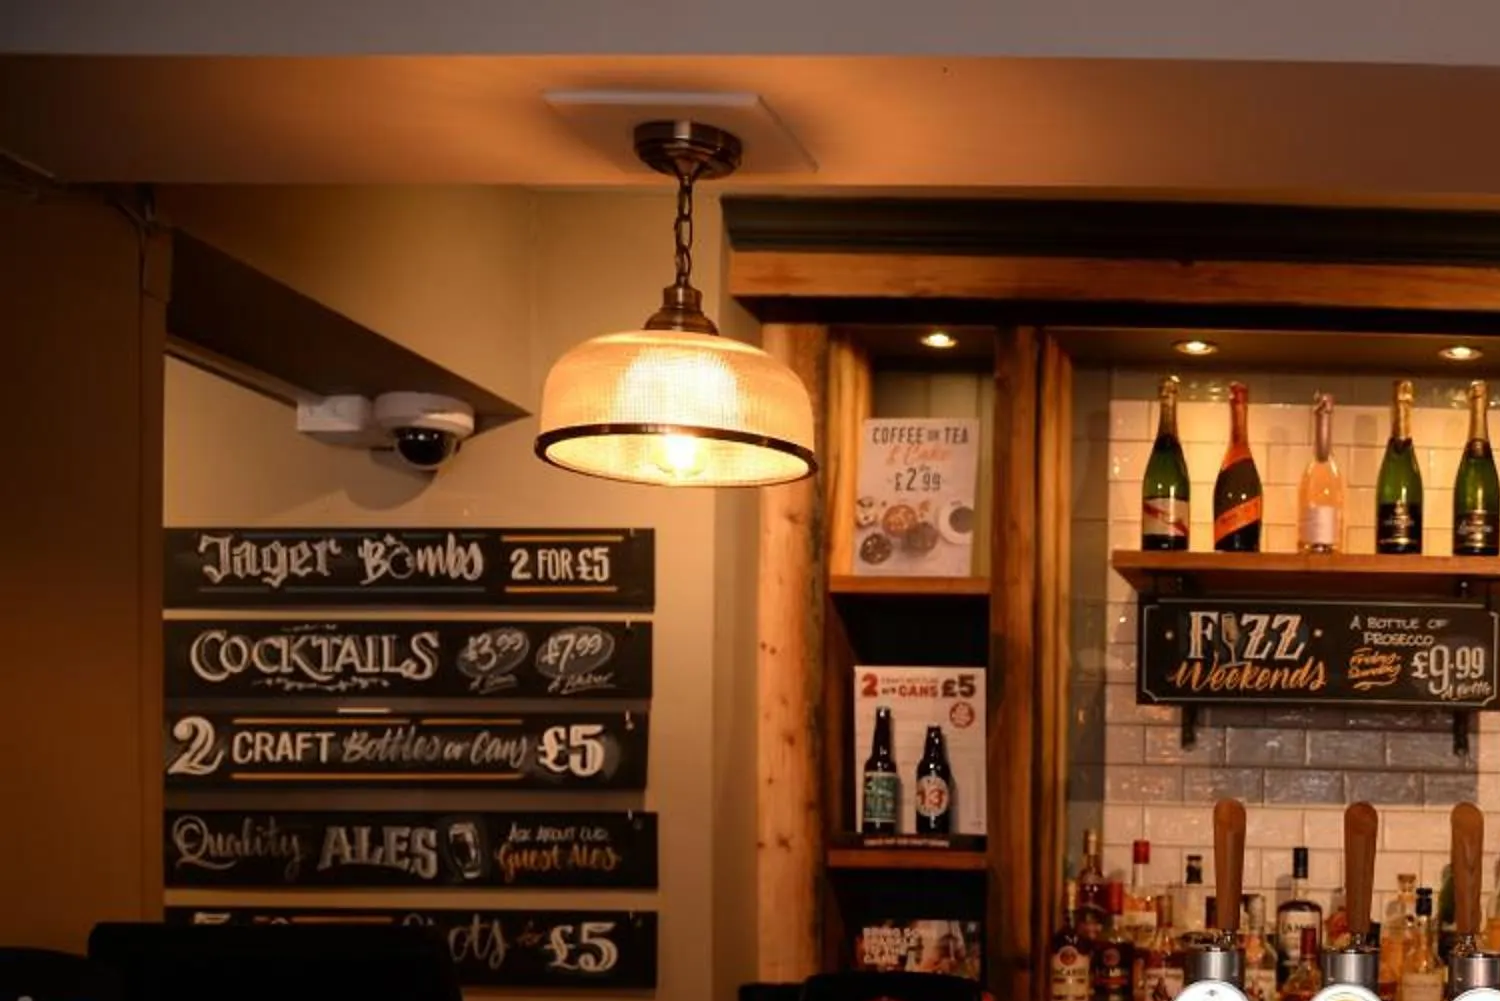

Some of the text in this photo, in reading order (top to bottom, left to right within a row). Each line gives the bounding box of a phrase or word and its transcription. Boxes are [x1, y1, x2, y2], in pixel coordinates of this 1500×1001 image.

[944, 427, 969, 444] TEA
[510, 549, 532, 581] 2
[536, 549, 574, 581] FOR
[576, 548, 611, 582] £5
[1350, 615, 1361, 630] A
[1363, 631, 1435, 647] PROSECCO
[862, 674, 878, 698] 2
[942, 674, 976, 699] £5
[1410, 644, 1486, 695] £9.99
[167, 716, 223, 776] 2
[231, 731, 336, 764] CRAFT
[537, 724, 606, 778] £5
[316, 824, 441, 880] ALES
[543, 921, 619, 973] £5
